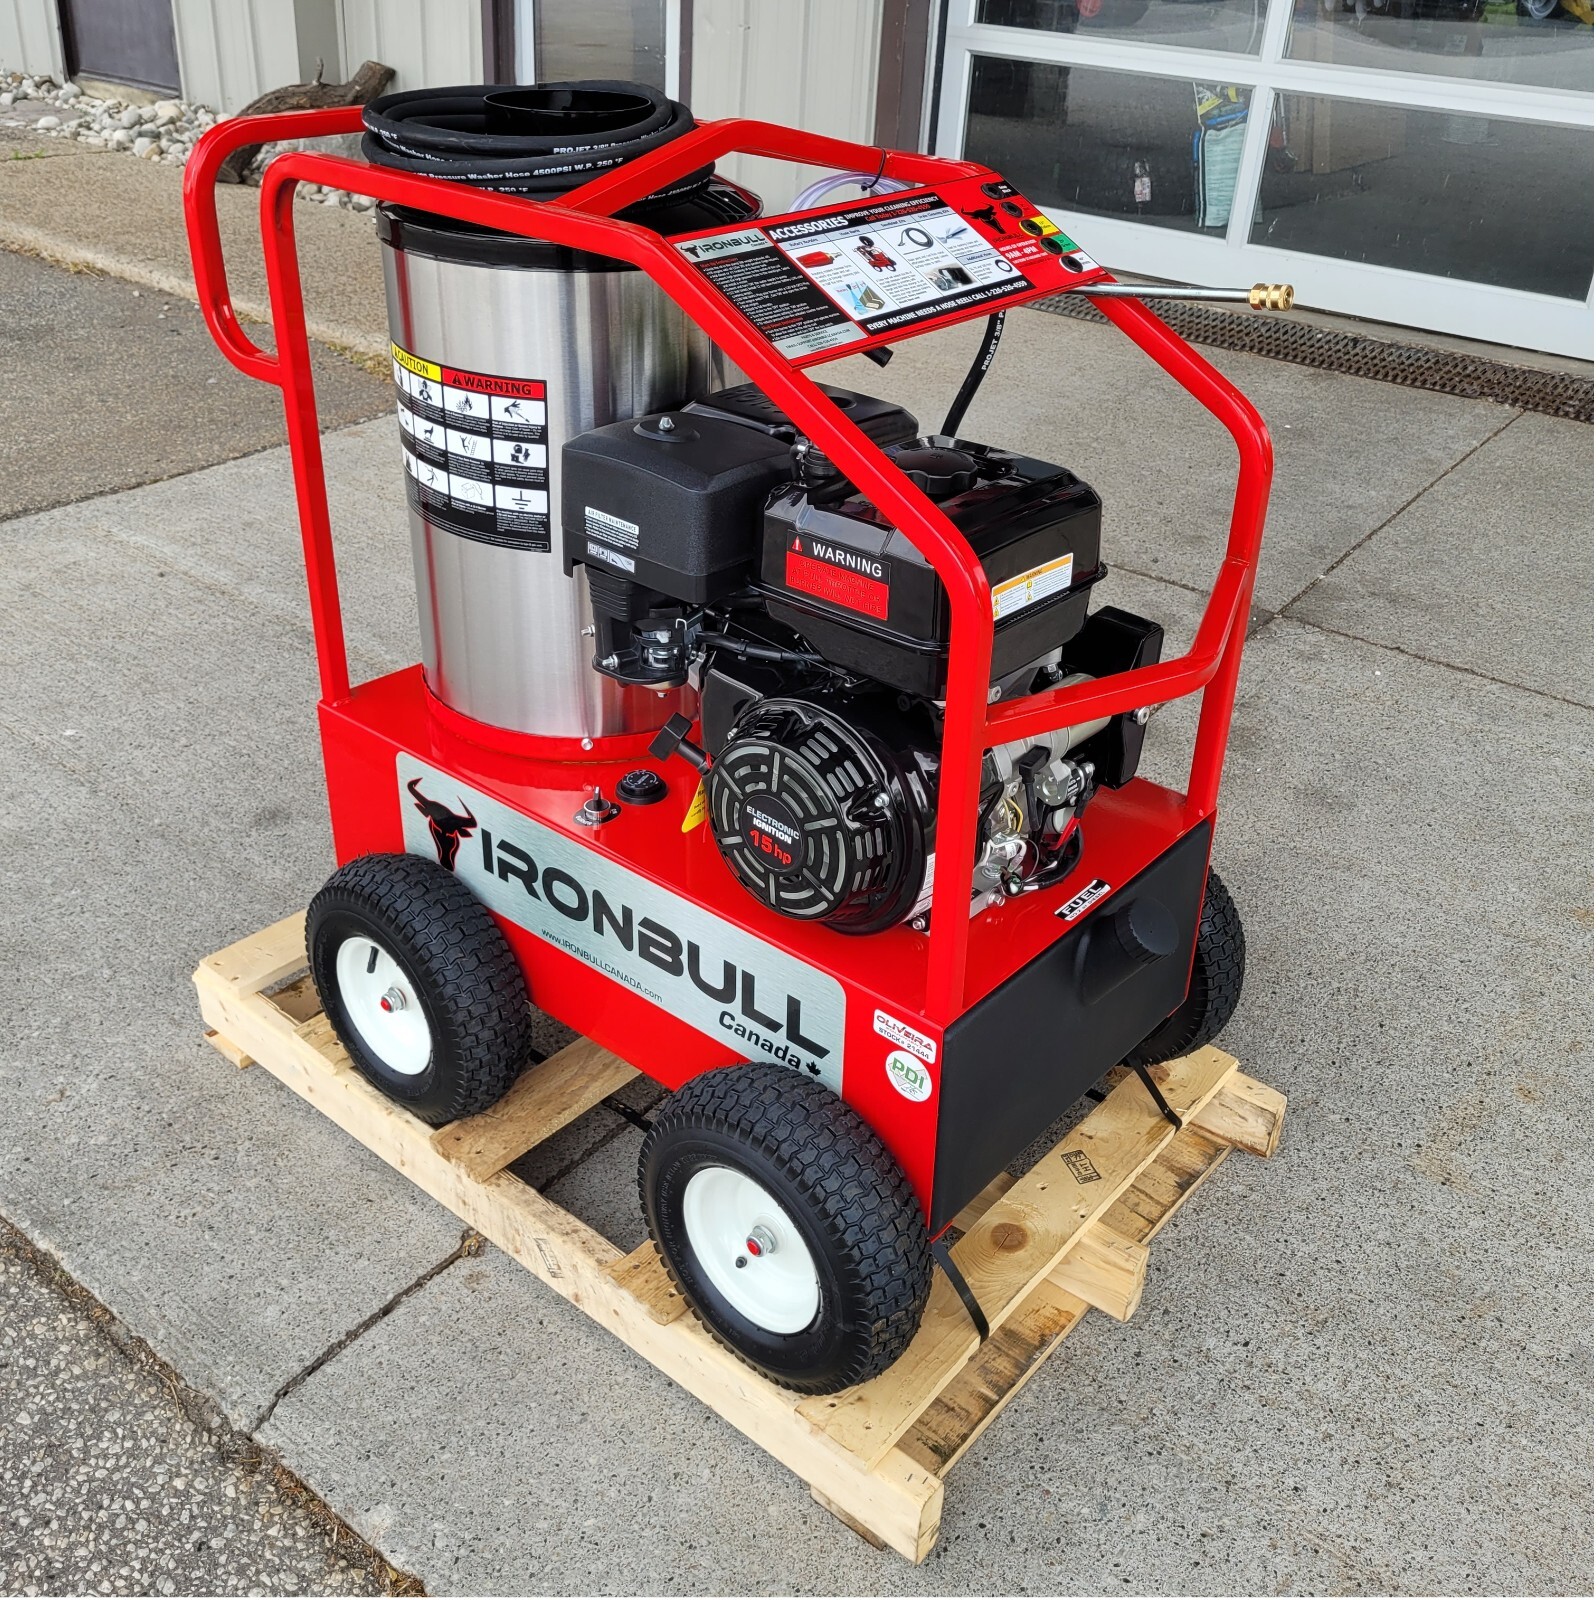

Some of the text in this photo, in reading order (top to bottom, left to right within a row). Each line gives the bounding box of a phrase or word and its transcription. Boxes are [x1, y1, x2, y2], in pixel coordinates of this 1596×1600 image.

[553, 145, 591, 154] PROJET
[467, 172, 504, 180] Washer
[532, 166, 572, 176] 4500PSI
[574, 162, 595, 172] W.P.
[596, 159, 613, 168] 250
[844, 210, 869, 220] IMPROVE
[884, 202, 911, 212] CLEANING
[910, 196, 939, 206] EFFICIENCY
[768, 216, 849, 240] ACCESSORIES
[698, 234, 766, 253] IRONBULL
[1005, 250, 1022, 260] 9AM
[1022, 246, 1039, 254] 4PM
[867, 321, 890, 331] EVERY
[887, 312, 918, 326] MACHINE
[916, 307, 938, 318] NEEDS
[941, 301, 958, 310] HOSE
[972, 292, 988, 300] CALL
[981, 338, 998, 371] PROJET
[994, 320, 1002, 338] 3/8"
[397, 350, 429, 376] CAUTION
[463, 376, 532, 396] WARNING
[596, 512, 608, 521] FILTER
[608, 516, 636, 532] MAINTENANCE
[800, 560, 836, 576] OPERATE
[812, 542, 882, 578] WARNING
[790, 575, 822, 592] BURNER
[863, 601, 882, 613] FIRE
[746, 805, 800, 840] ELECTRONIC
[752, 817, 792, 845] IGNITION
[1062, 886, 1102, 915] FUEL
[480, 827, 831, 1060] IRONBULL
[542, 928, 663, 1003] www.IRONBULLCANADA.com
[718, 1009, 803, 1071] Canada
[876, 1015, 934, 1052] OLIVEIRA
[892, 1056, 925, 1090] PDI
